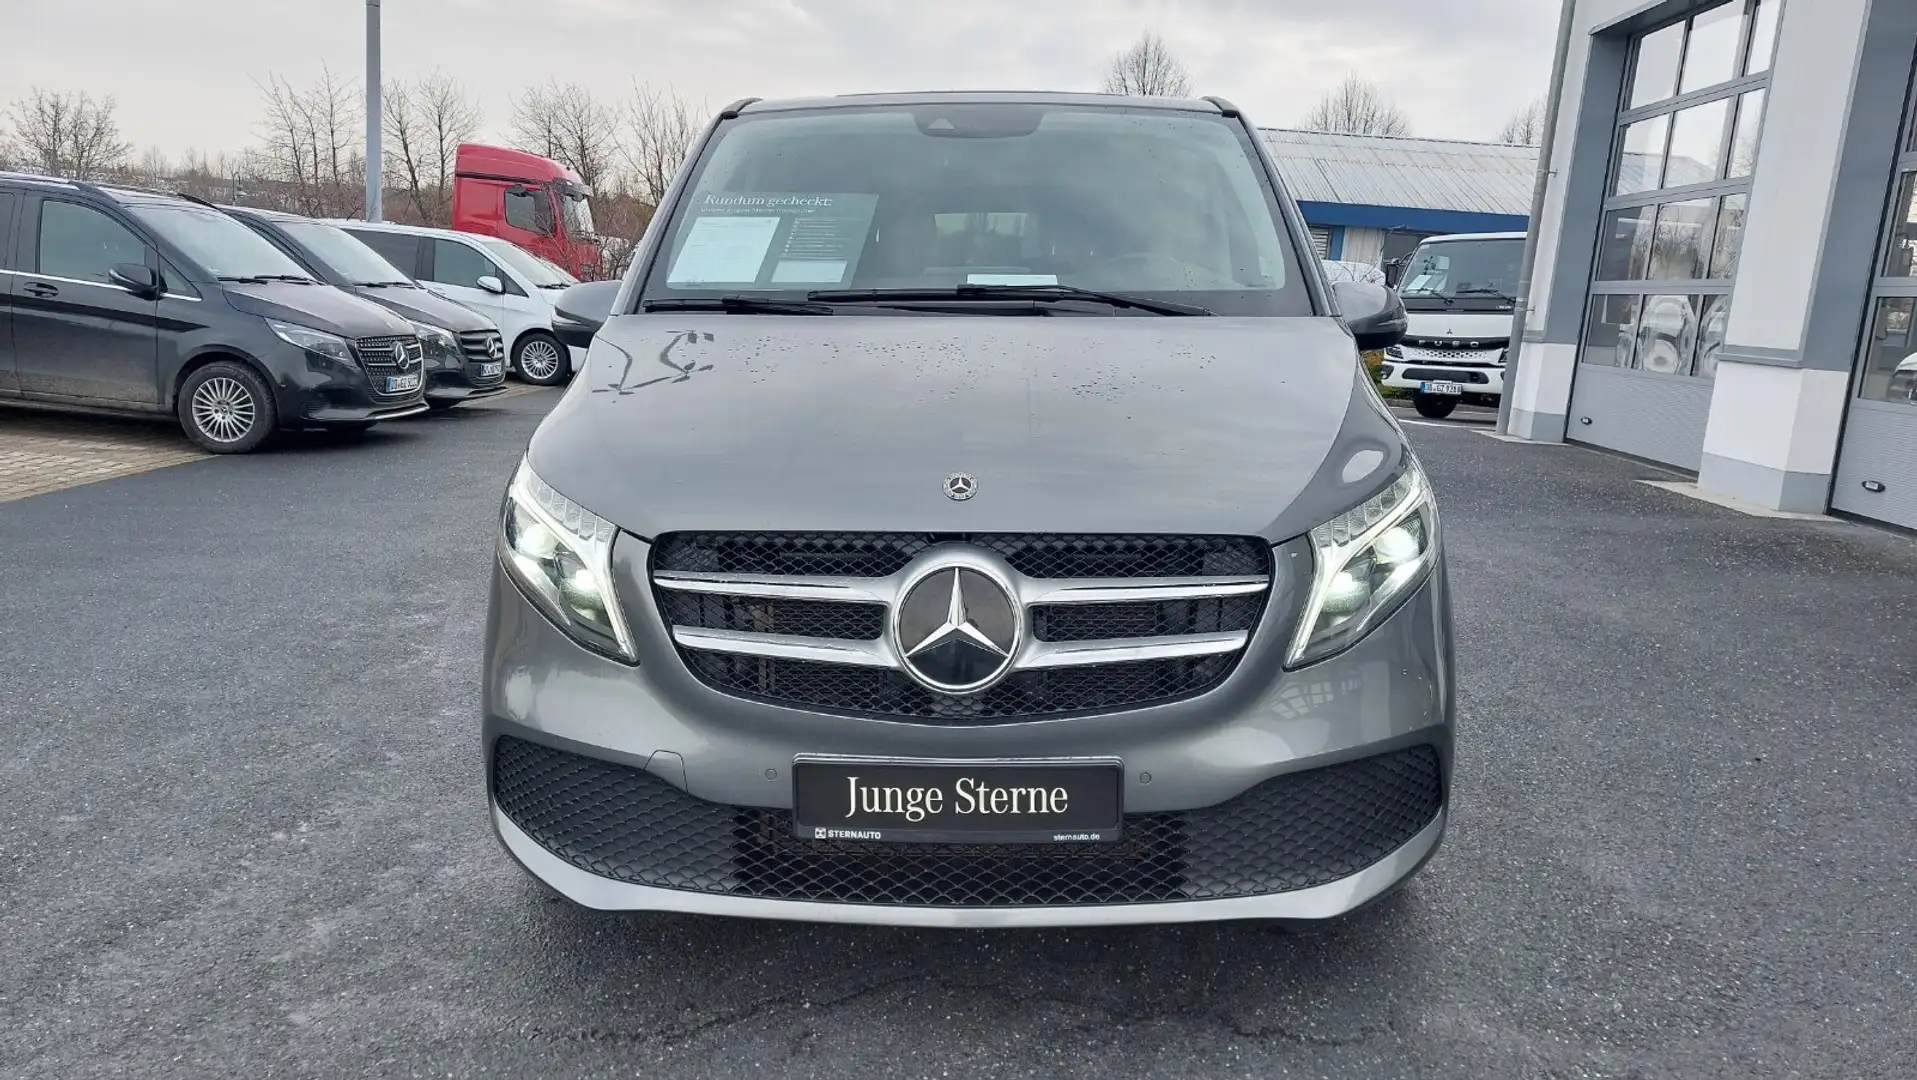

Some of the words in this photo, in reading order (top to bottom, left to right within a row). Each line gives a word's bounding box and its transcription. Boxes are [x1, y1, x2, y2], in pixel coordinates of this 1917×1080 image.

[704, 194, 764, 206] Rundum
[845, 776, 943, 822] Junge
[955, 777, 1068, 814] Sterne
[828, 830, 881, 839] STERNAUTO
[1053, 833, 1100, 841] sternauto.de
